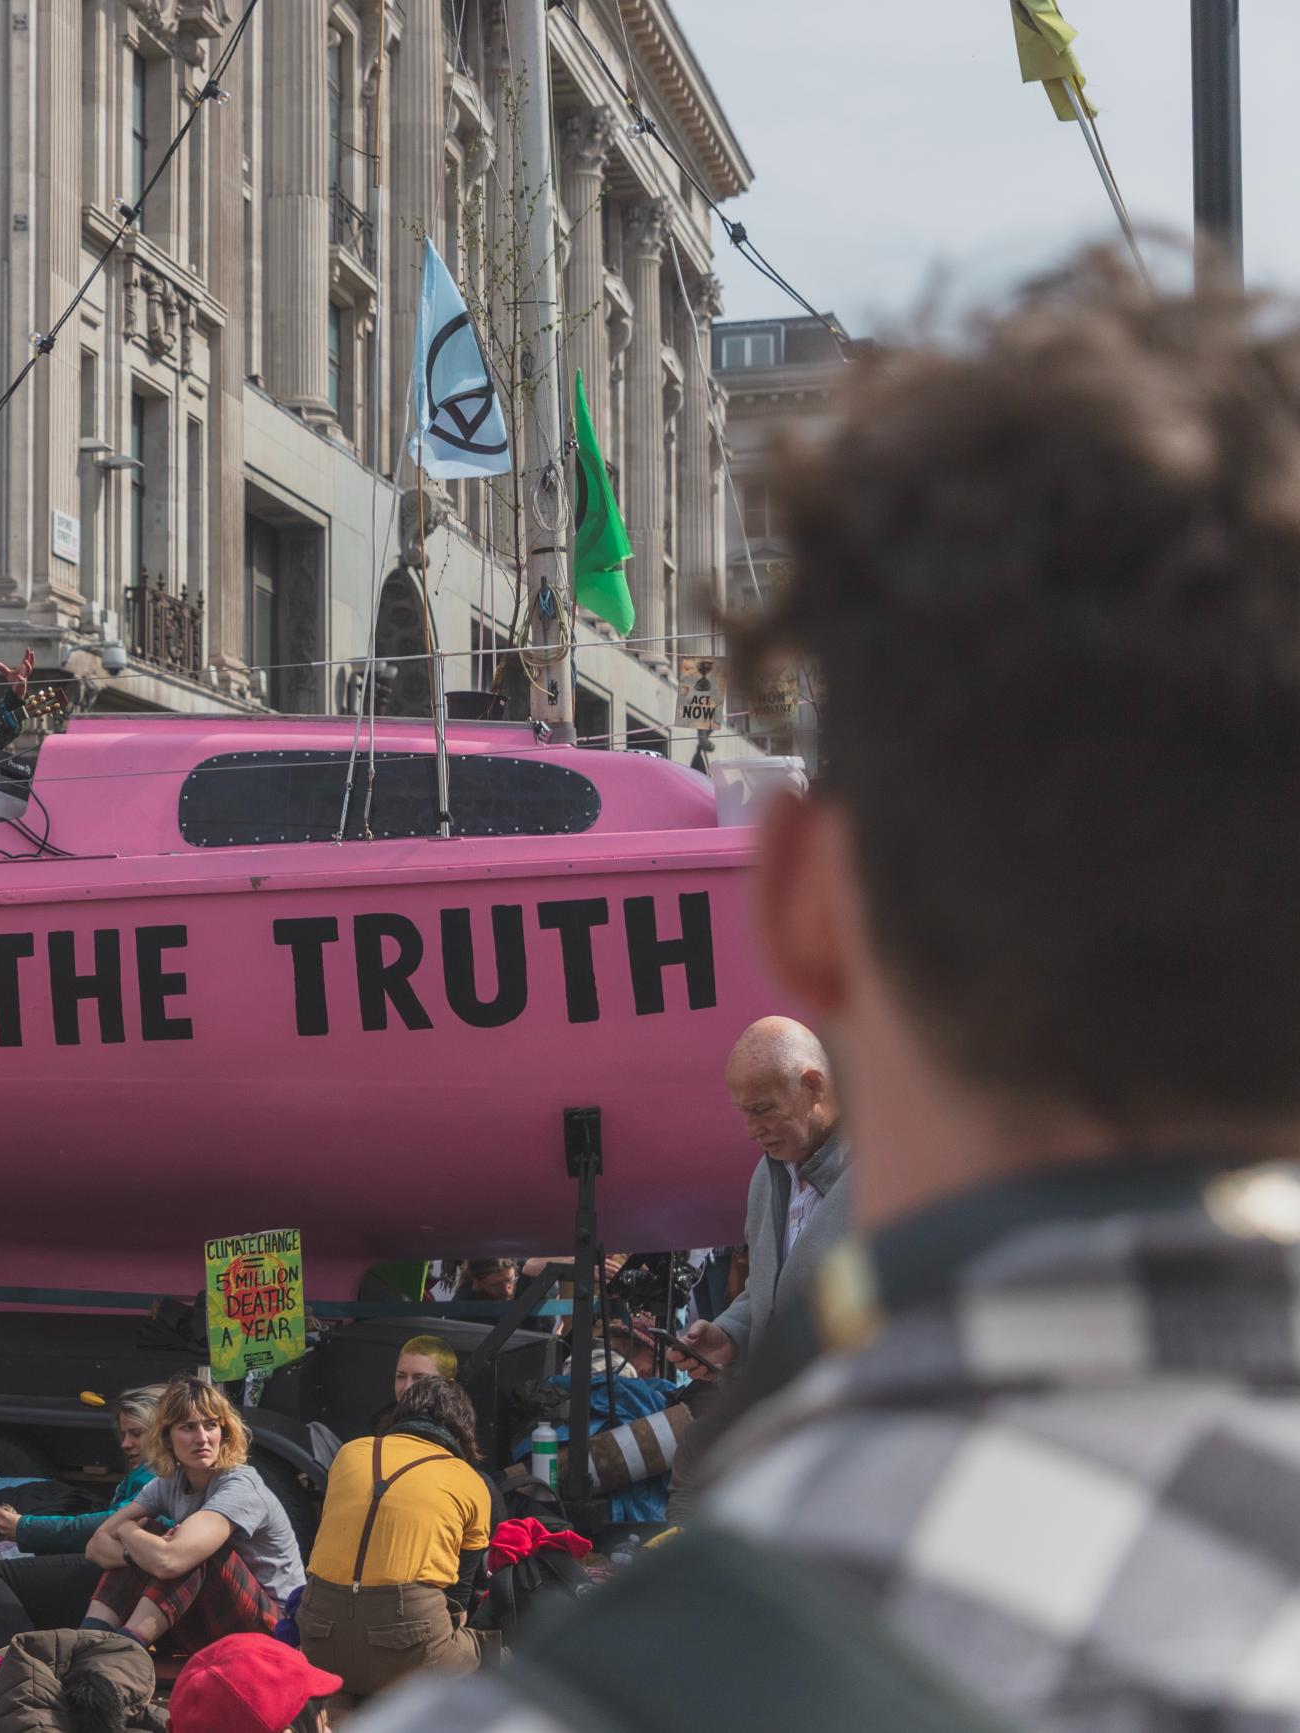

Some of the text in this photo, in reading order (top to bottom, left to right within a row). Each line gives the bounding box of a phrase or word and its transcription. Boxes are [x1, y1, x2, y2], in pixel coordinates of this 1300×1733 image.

[682, 705, 716, 720] NOW
[691, 695, 711, 706] ACT
[273, 891, 717, 1036] TRUTH
[206, 1229, 300, 1260] CLIMATE CHANGE
[216, 1265, 299, 1292] 5 MILLION
[226, 1287, 296, 1318] DEATHS
[221, 1317, 293, 1348] A YEAR
